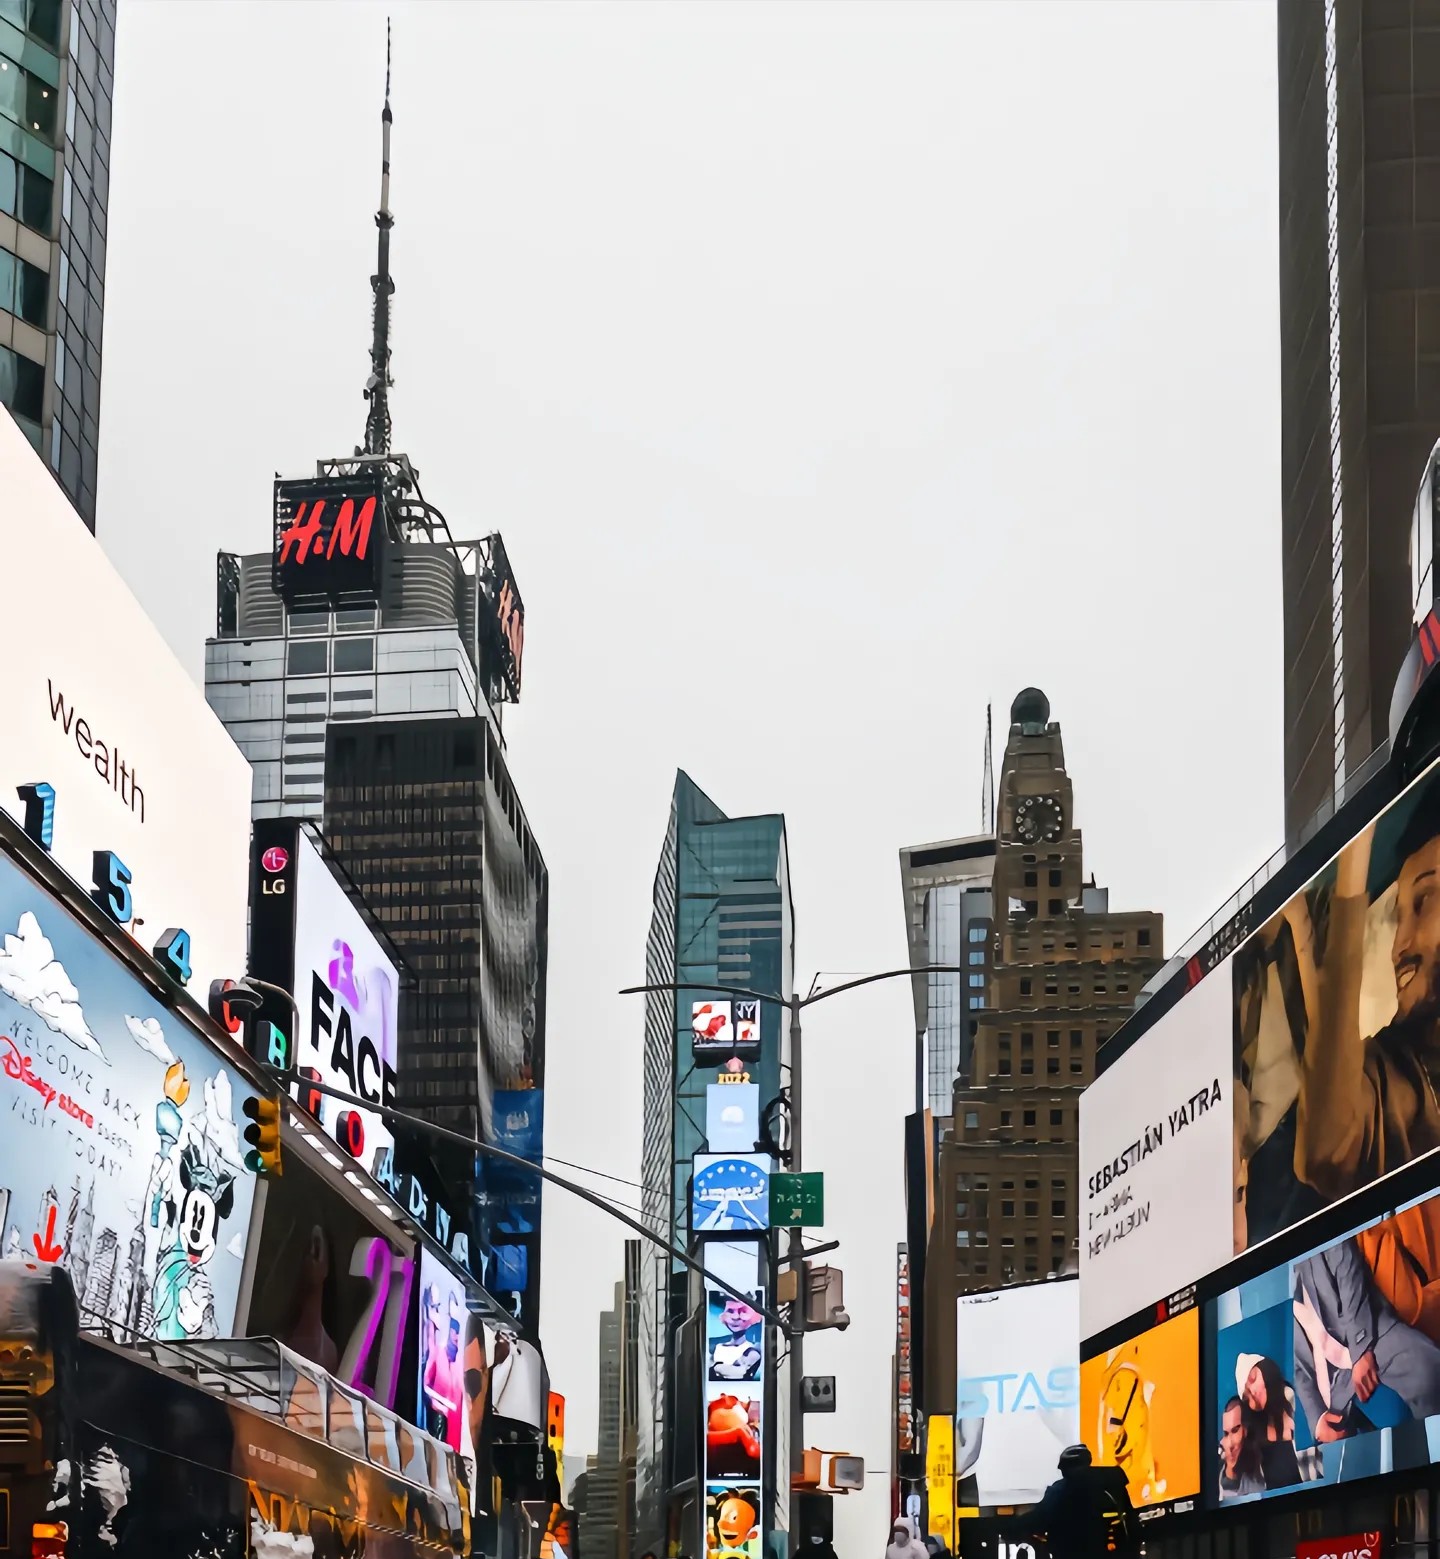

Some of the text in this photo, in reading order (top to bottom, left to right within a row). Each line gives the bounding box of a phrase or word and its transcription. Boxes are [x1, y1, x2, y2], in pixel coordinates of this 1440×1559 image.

[279, 496, 377, 565] H&M
[47, 679, 146, 824] wealth
[262, 878, 286, 896] LG
[1088, 1078, 1222, 1199] SEBASTIÁN YATRA
